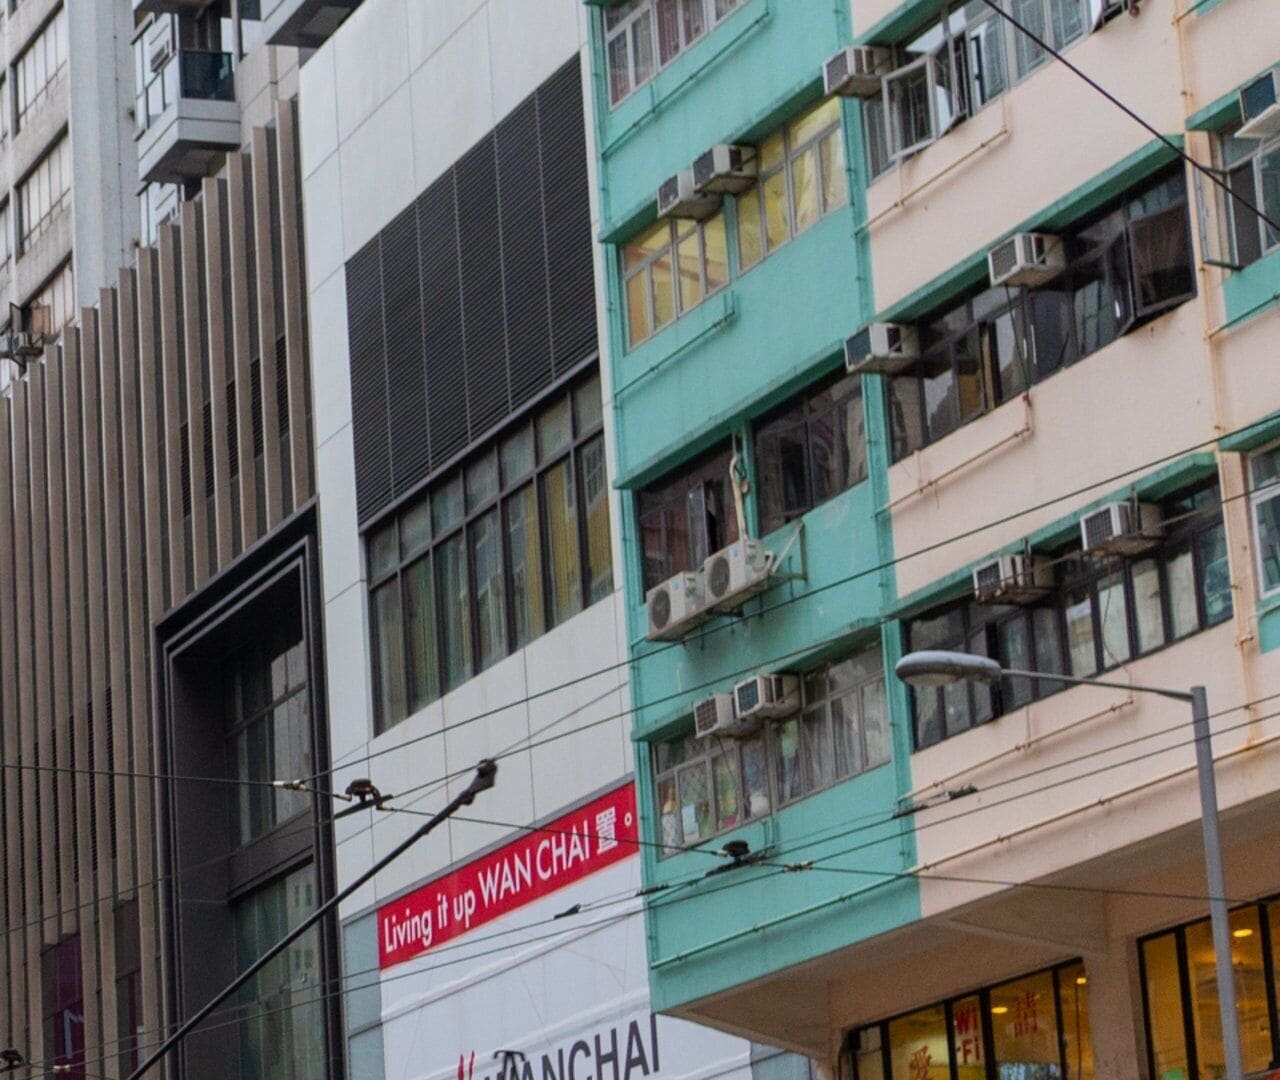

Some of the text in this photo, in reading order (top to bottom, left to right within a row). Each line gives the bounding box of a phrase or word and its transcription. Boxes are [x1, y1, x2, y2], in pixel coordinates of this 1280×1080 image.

[383, 820, 590, 953] Living it up WAN CHAI
